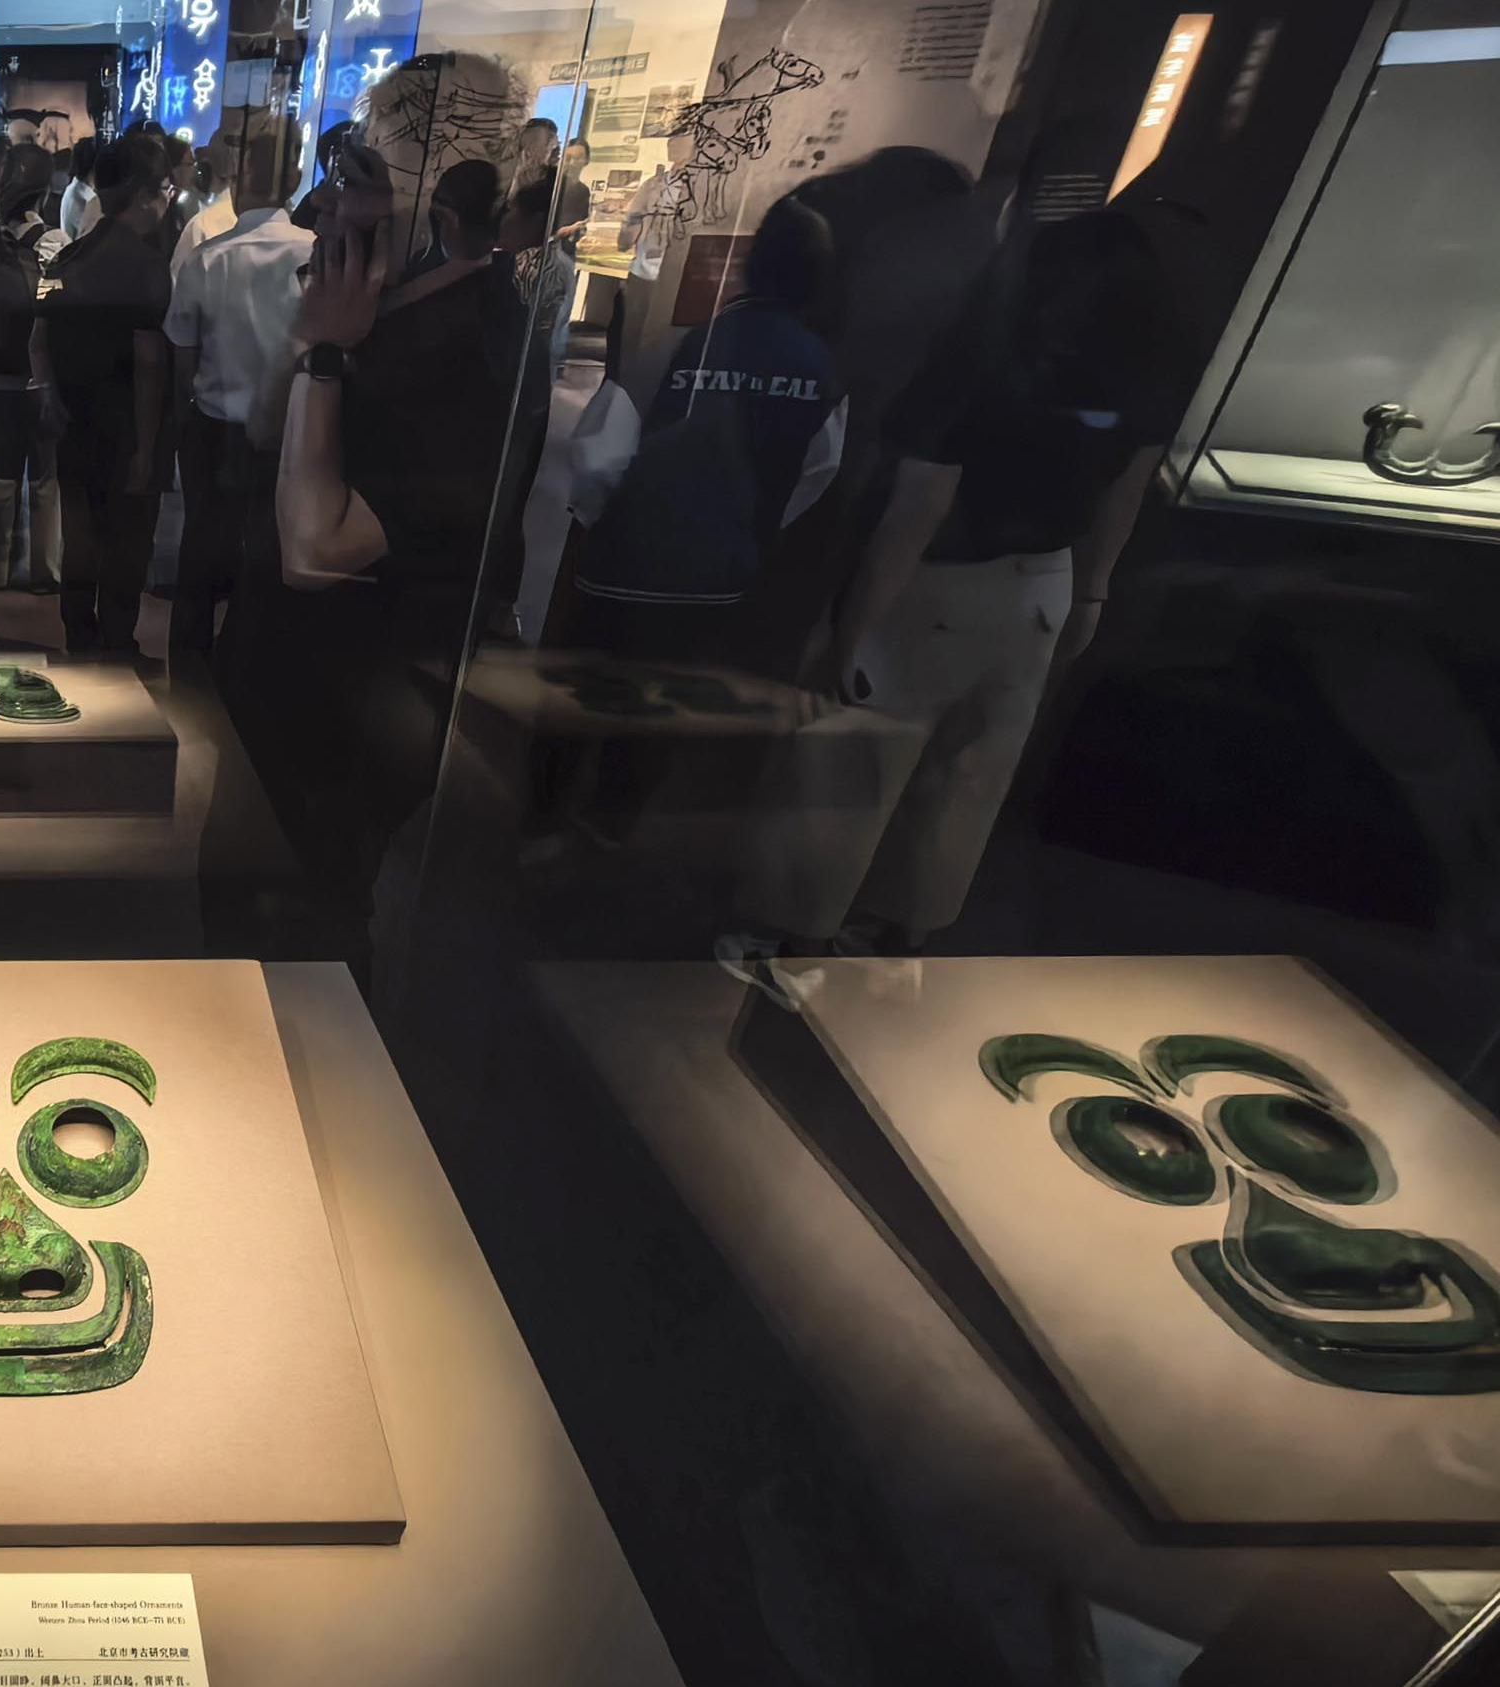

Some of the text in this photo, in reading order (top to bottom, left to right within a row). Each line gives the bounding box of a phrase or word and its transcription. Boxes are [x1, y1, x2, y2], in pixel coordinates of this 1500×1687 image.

[31, 1600, 58, 1609] Bronze
[139, 1601, 183, 1609] Ornaments
[88, 1616, 110, 1624] Period
